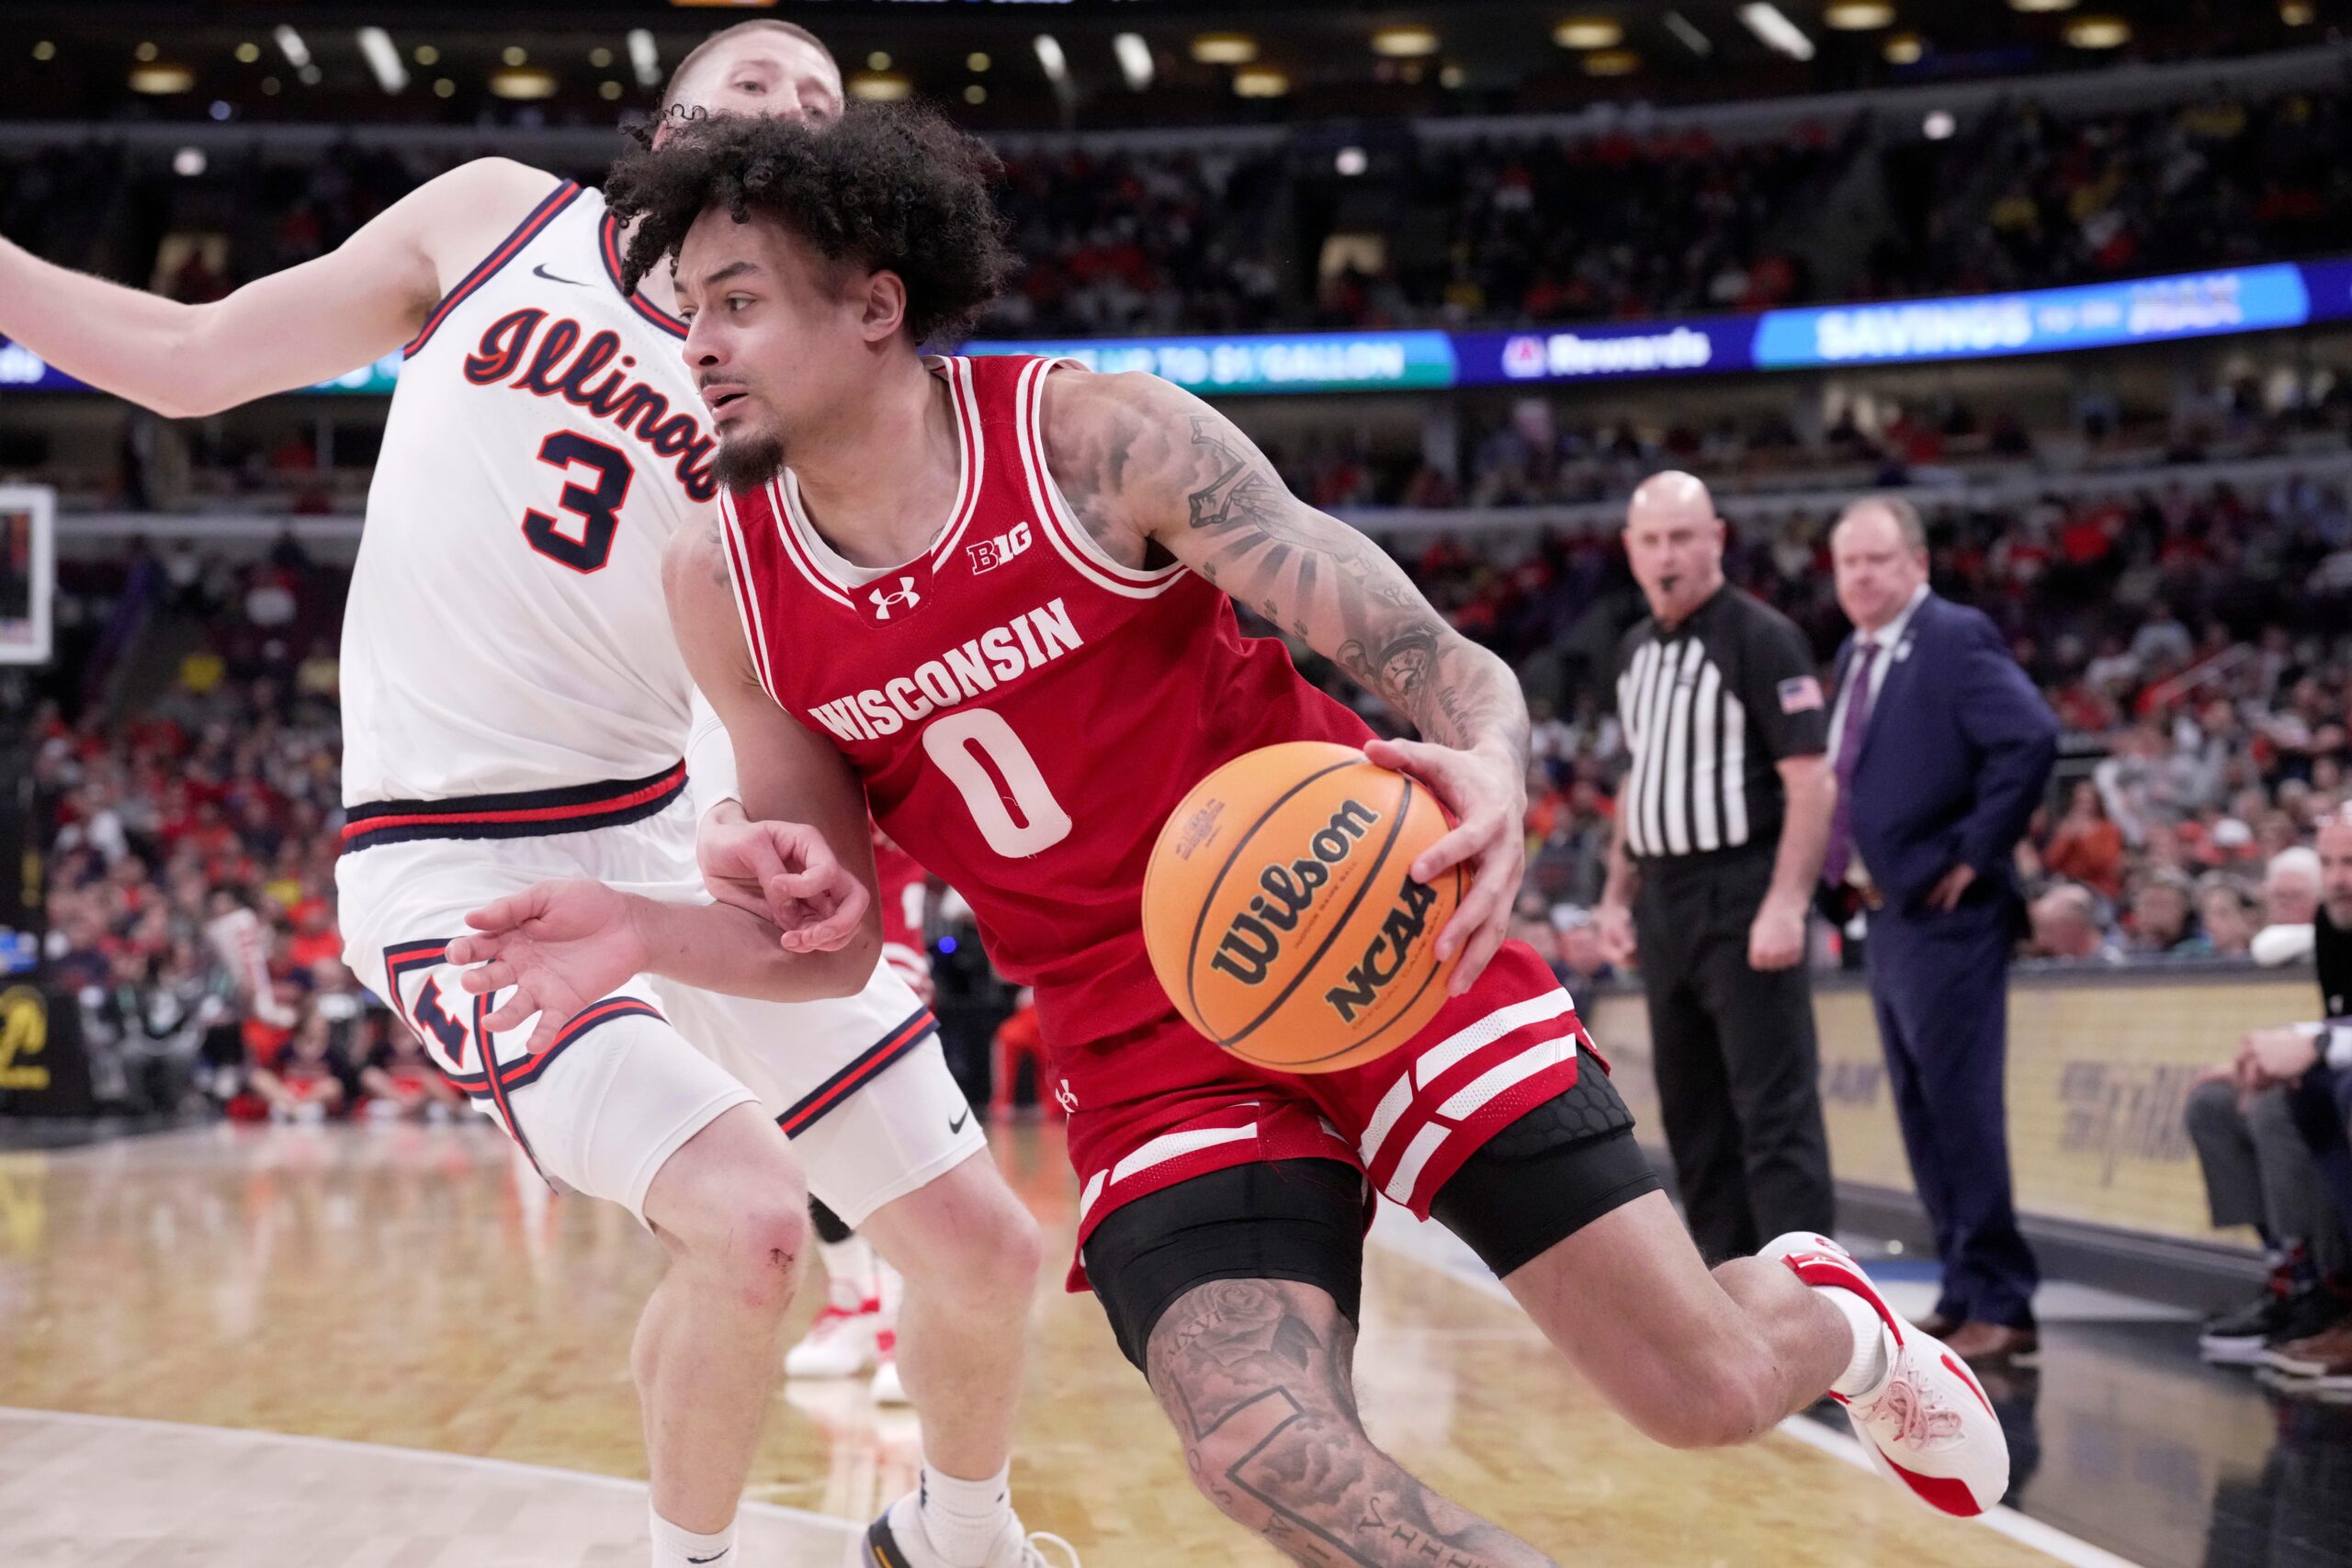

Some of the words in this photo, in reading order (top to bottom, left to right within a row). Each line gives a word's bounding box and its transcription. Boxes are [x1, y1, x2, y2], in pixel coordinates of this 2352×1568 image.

[521, 429, 635, 574] 3
[808, 597, 1084, 741] WISCONSIN
[922, 708, 1072, 858] 0
[1210, 798, 1382, 987] Wilson
[1324, 874, 1439, 1024] NCAA
